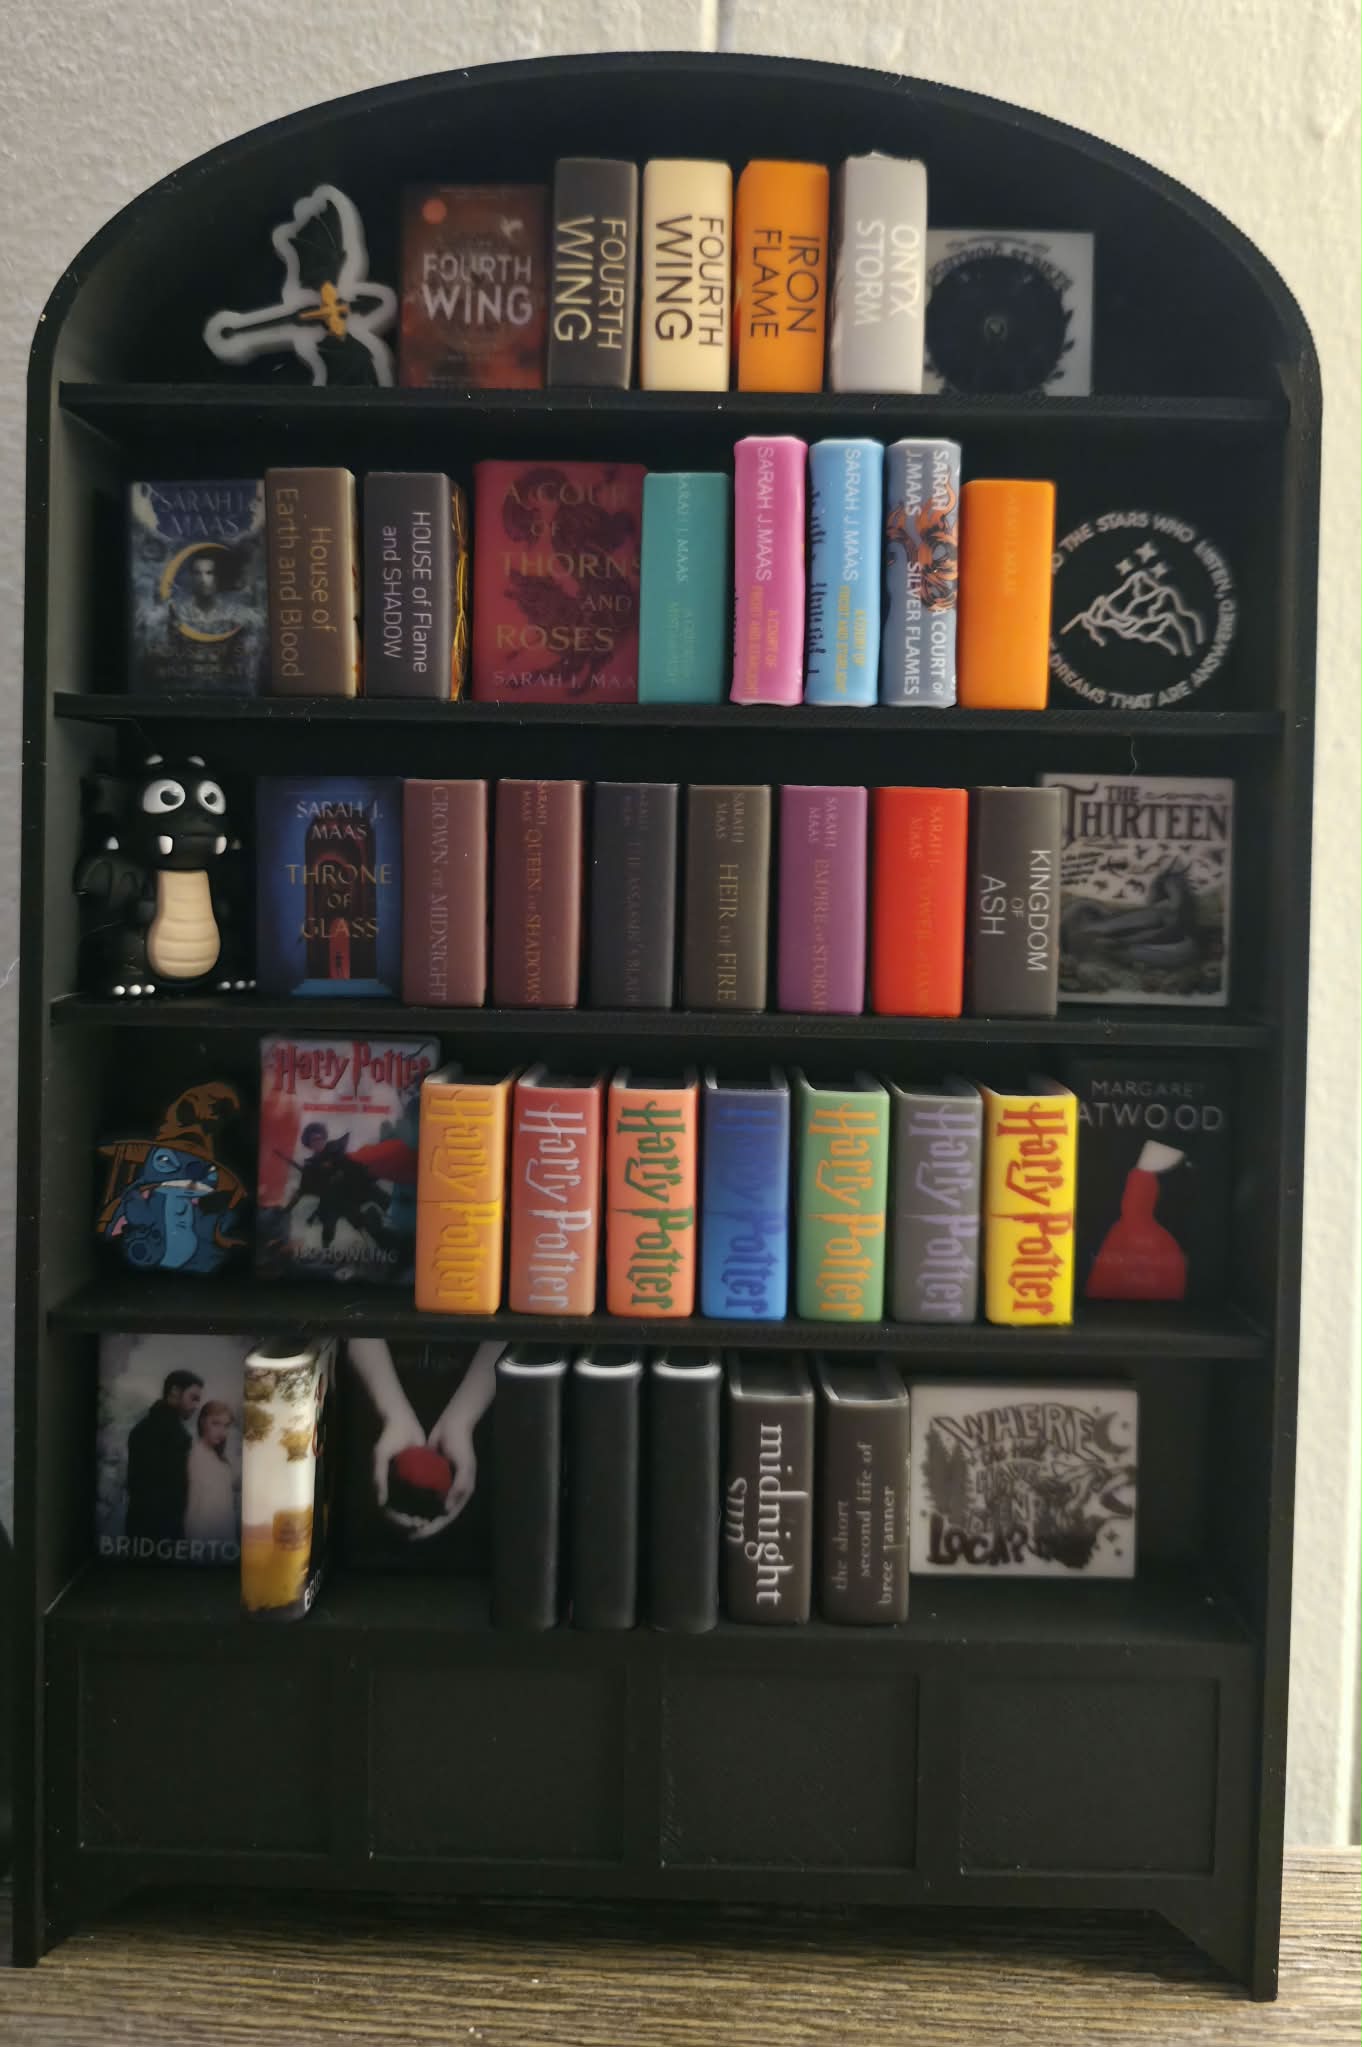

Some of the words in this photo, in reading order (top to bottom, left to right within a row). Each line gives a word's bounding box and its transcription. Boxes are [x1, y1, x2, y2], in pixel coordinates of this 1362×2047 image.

[422, 253, 533, 283] FOURTH
[553, 215, 595, 342] WING
[597, 218, 627, 350] FOURTH
[654, 214, 693, 342] WING
[698, 216, 724, 347] FOURTH
[750, 229, 782, 338] FLAME
[786, 235, 820, 335] IRON
[854, 219, 886, 327] STORM
[889, 224, 921, 319] ONYX
[422, 284, 533, 326] WING
[505, 484, 521, 505] A
[756, 446, 775, 513] SARAH
[843, 447, 861, 511] SARAH
[931, 450, 949, 511] SARAH
[275, 488, 301, 550] Earth
[380, 524, 401, 564] and
[411, 511, 432, 582] HOUSE
[529, 521, 560, 537] OF
[1096, 509, 1151, 533] STARS
[1151, 513, 1197, 544] WHO
[278, 557, 304, 601] and
[309, 526, 334, 603] House
[905, 560, 924, 622] SILVER
[313, 607, 338, 634] of
[382, 567, 404, 659] SHADOW
[412, 586, 432, 609] of
[580, 594, 633, 613] AND
[278, 609, 305, 678] Blood
[411, 612, 433, 673] Flame
[495, 624, 617, 653] ROSES
[903, 626, 922, 696] FLAMES
[929, 620, 947, 679] COURT
[1108, 689, 1156, 710] THAT
[1156, 679, 1193, 708] ARE
[1190, 599, 1238, 688] ANSWERED
[492, 670, 563, 690] SARAH
[590, 671, 638, 690] MAA
[295, 799, 364, 820] SARAH
[1048, 781, 1229, 848] THIRTEEN
[1103, 785, 1142, 801] THE
[311, 823, 369, 842] MAAS
[431, 786, 449, 867] CROWN
[285, 863, 393, 887] THRONE
[525, 828, 545, 891] QUEEN
[812, 857, 833, 924] EMPIRE
[327, 892, 353, 909] OF
[718, 863, 740, 921] HEIR
[978, 872, 1009, 936] ASH
[1010, 897, 1024, 920] OF
[1025, 849, 1053, 972] KINGDOM
[299, 916, 381, 941] GLASS
[428, 893, 449, 1001] MIDNIGHT
[525, 912, 545, 1003] SHADOWS
[716, 952, 738, 1001] FIRE
[272, 1040, 349, 1094] Harry
[351, 1040, 431, 1096] Potter
[1090, 1079, 1205, 1098] MARGARE
[426, 1088, 493, 1192] Harry
[1078, 1101, 1226, 1132] ATWOOD
[518, 1103, 588, 1204] Harry
[615, 1101, 686, 1204] Harry
[809, 1101, 881, 1208] Harry
[909, 1103, 979, 1210] Harry
[996, 1101, 1068, 1208] Harry
[528, 1207, 593, 1310] Potter
[612, 1206, 694, 1310] Potter
[707, 1209, 787, 1315] Potter
[807, 1210, 886, 1319] Potter
[903, 1212, 979, 1318] Potter
[990, 1209, 1075, 1317] Potter
[857, 1441, 873, 1464] of
[931, 1402, 1107, 1464] WHERE
[725, 1476, 749, 1547] sun
[744, 1420, 810, 1609] midnight
[857, 1470, 873, 1504] life
[98, 1535, 240, 1562] BRIDGERTO
[831, 1499, 849, 1554] short
[856, 1510, 873, 1578] second
[830, 1560, 849, 1591] the
[876, 1560, 896, 1606] bree
